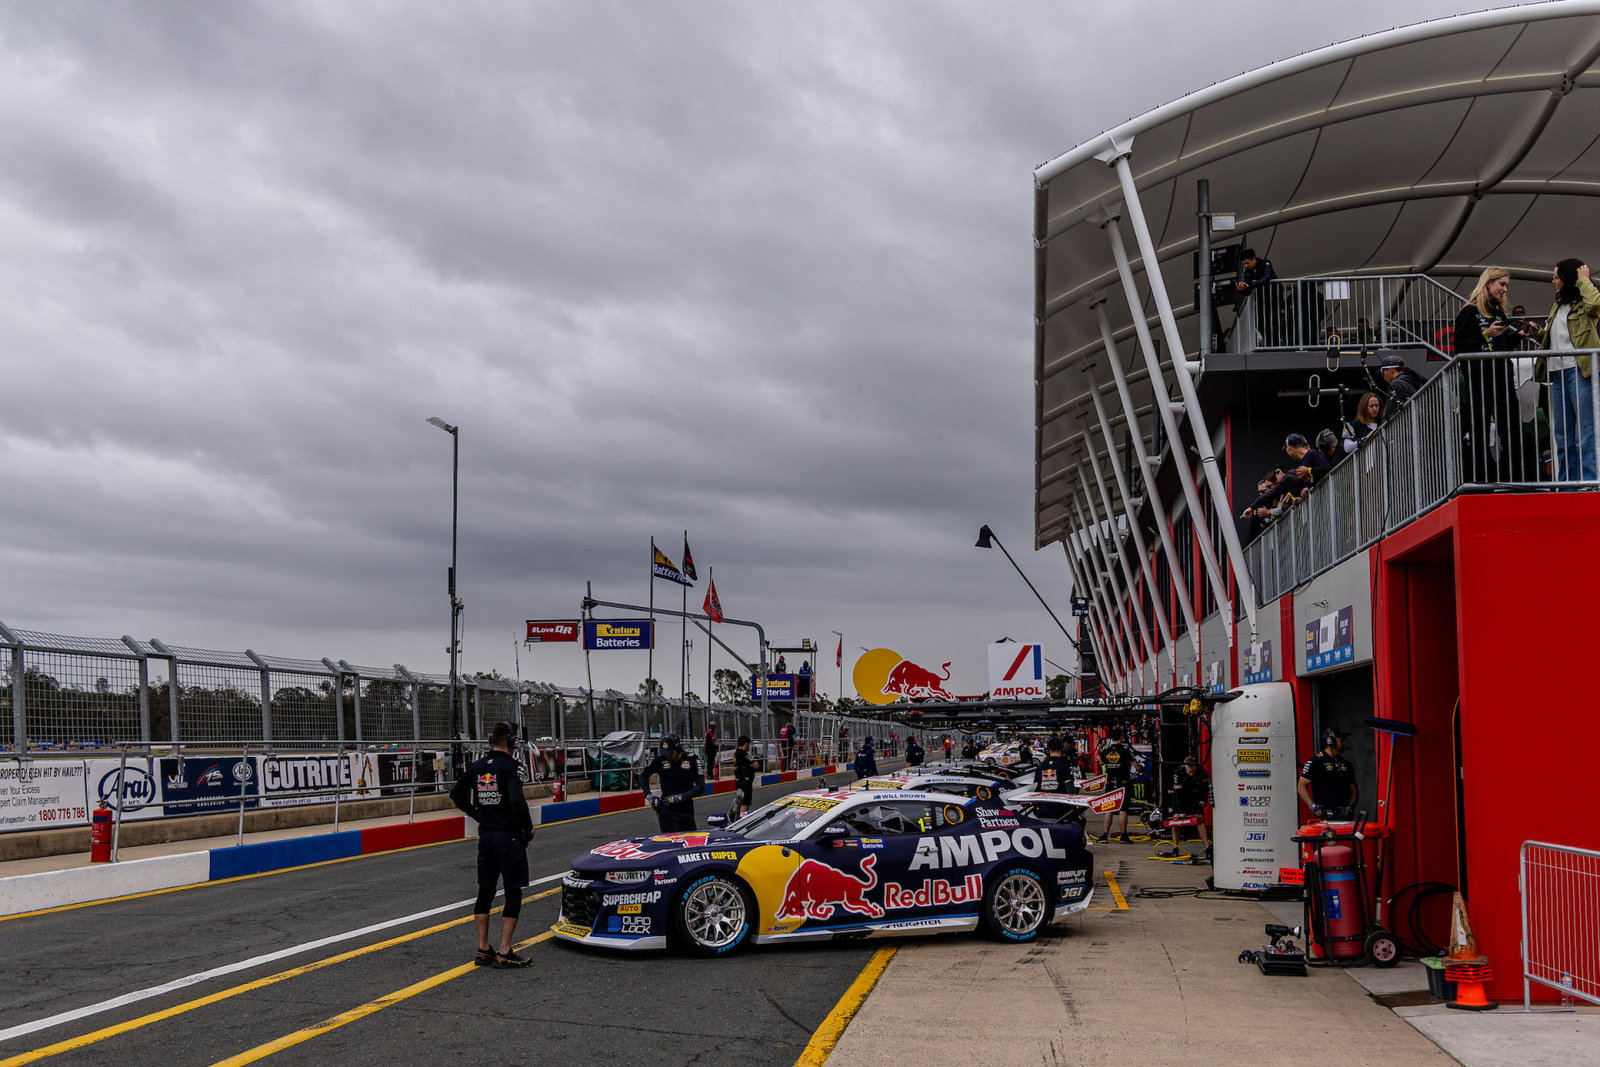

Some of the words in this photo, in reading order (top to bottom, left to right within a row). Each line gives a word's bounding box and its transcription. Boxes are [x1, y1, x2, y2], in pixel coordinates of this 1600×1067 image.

[596, 638, 640, 647] Batteries
[756, 688, 790, 696] Btteries
[993, 687, 1043, 696] AMPOL
[29, 768, 42, 780] BEEN
[43, 768, 53, 778] HIT
[54, 767, 61, 778] BY
[264, 759, 351, 790] CUTRITE
[10, 786, 21, 795] Your
[22, 785, 40, 794] Excess
[103, 771, 149, 800] Arai
[12, 797, 26, 807] Claim
[28, 796, 60, 807] Management
[1091, 792, 1123, 809] SUPERCHEAP
[1102, 802, 1116, 810] AUTO
[39, 809, 56, 821] 1800
[58, 808, 71, 820] 776
[72, 807, 85, 818] 786
[976, 808, 999, 818] Shaw
[980, 817, 1019, 828] Partners
[908, 828, 1066, 871] AMPOL
[677, 853, 701, 864] MAKE
[702, 852, 710, 860] IT
[710, 851, 738, 860] SUPER
[1009, 868, 1040, 880] DUNLOP
[602, 890, 662, 906] SUPERCHEAP
[1062, 887, 1083, 898] JGI
[622, 916, 651, 925] QUAD
[621, 925, 651, 934] LOCK
